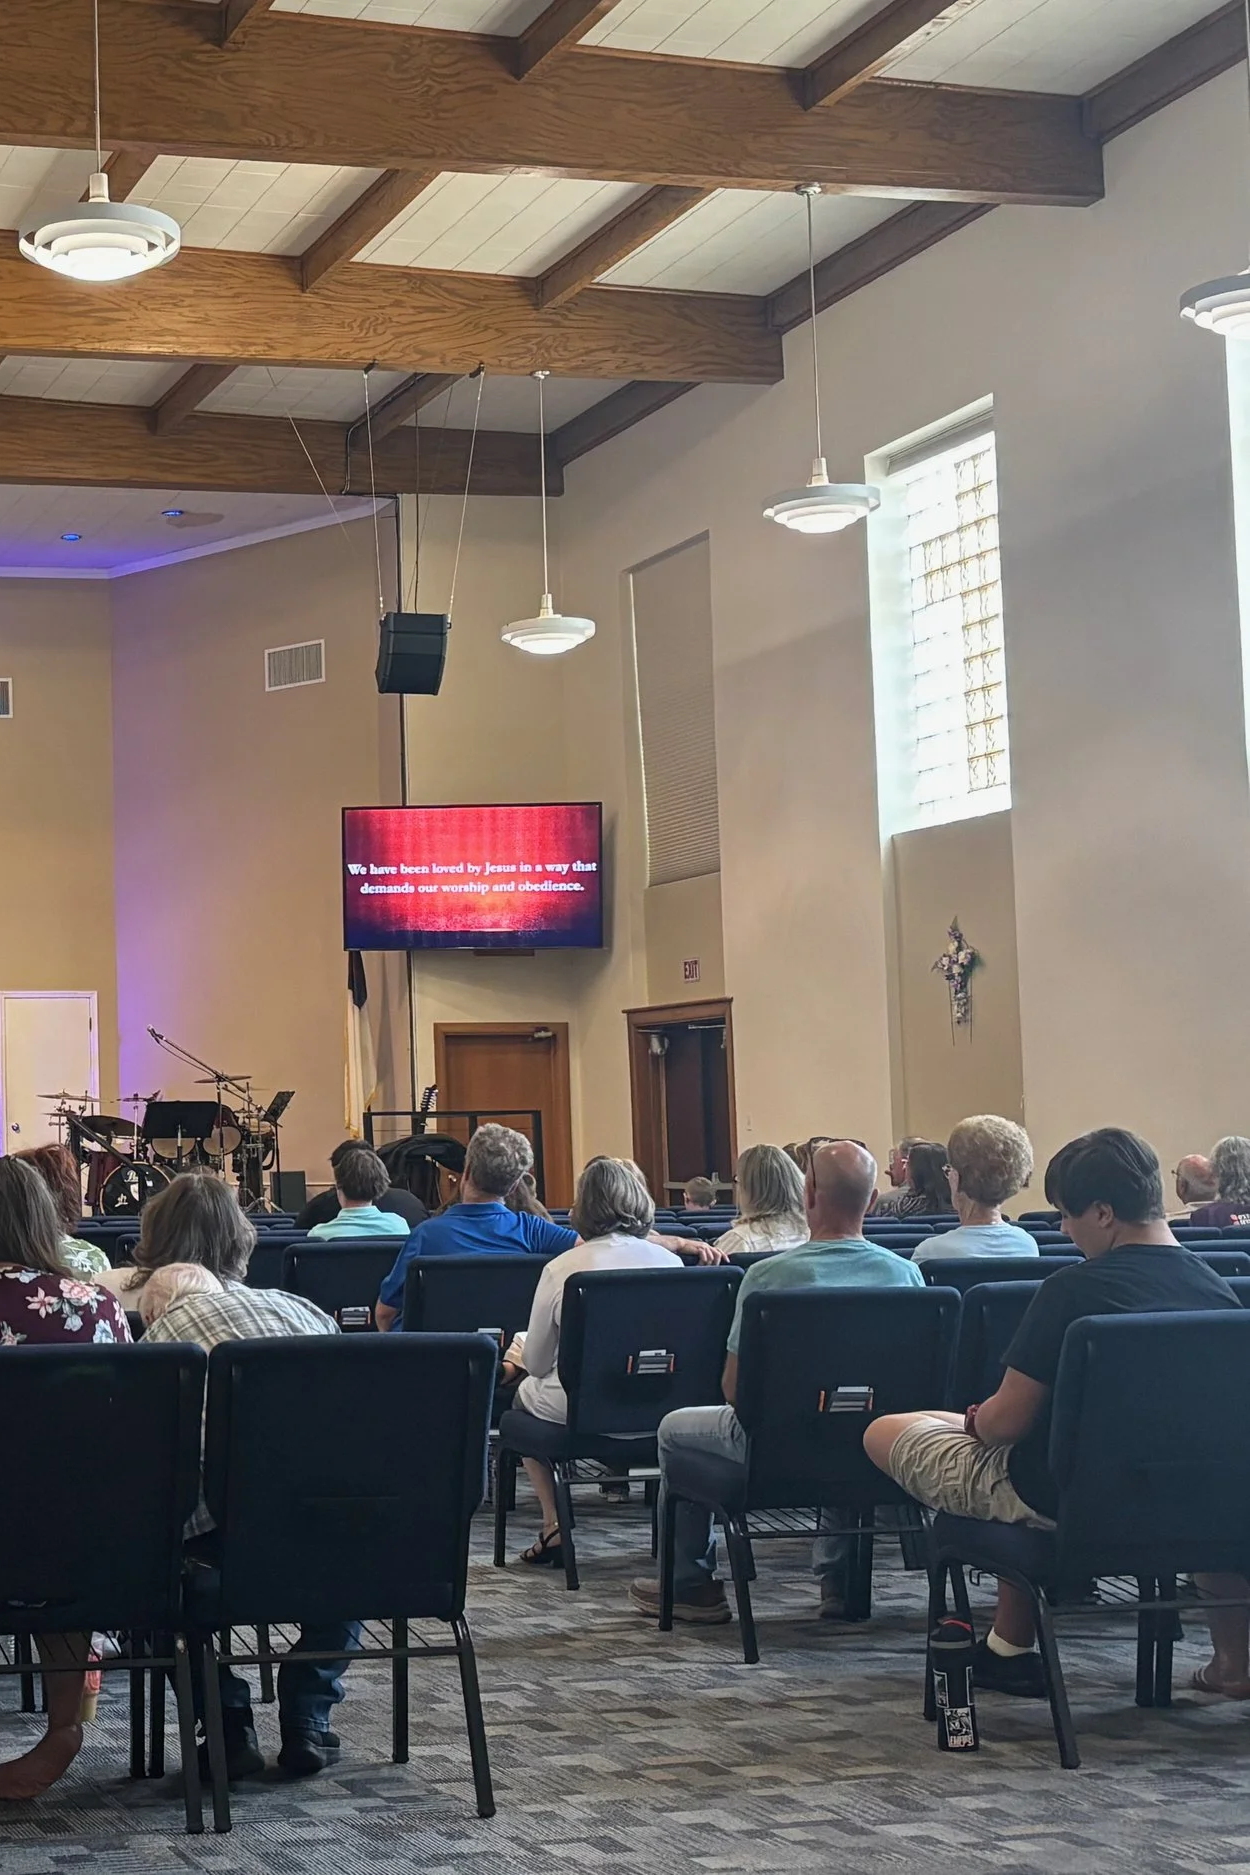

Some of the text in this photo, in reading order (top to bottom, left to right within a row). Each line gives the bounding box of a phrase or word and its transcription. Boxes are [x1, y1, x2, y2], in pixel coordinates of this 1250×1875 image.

[347, 860, 597, 877] We have been loved by Jesus in a way that
[360, 880, 585, 896] demands our worship and obedience.
[684, 960, 698, 979] EXIT
